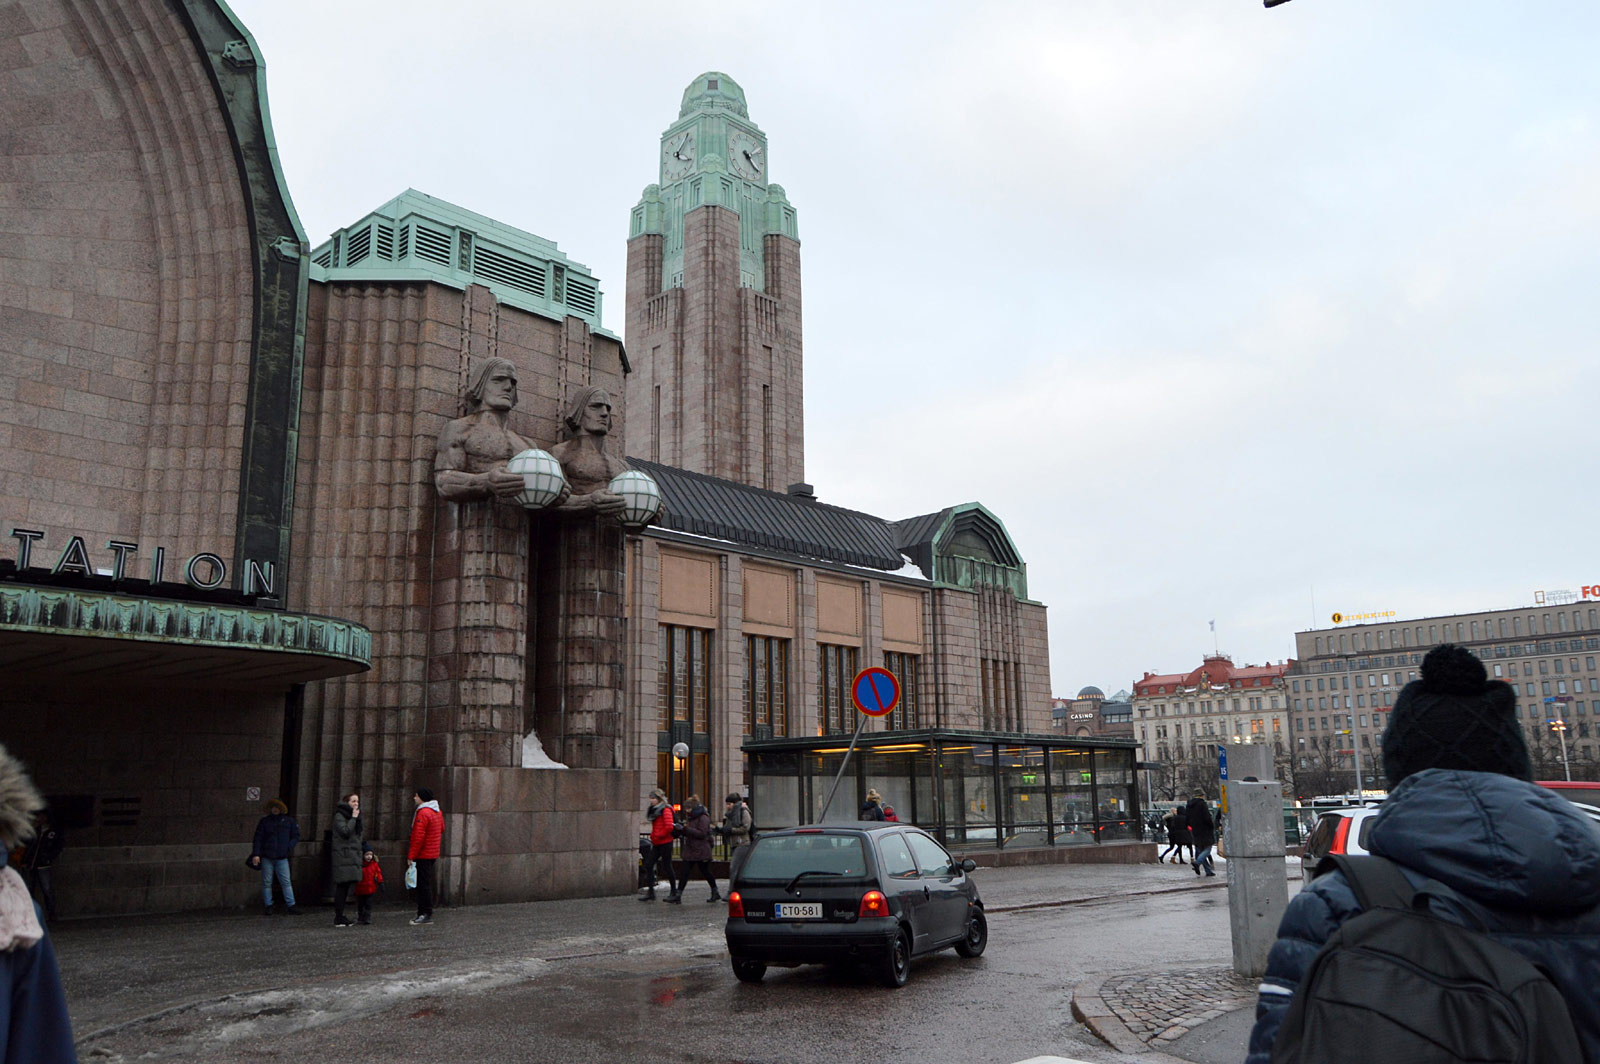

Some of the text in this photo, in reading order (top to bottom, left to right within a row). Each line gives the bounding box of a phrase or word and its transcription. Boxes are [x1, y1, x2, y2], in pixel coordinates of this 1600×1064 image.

[10, 528, 276, 596] TATION
[1070, 712, 1094, 720] CASINO
[782, 906, 819, 916] CTO-581
